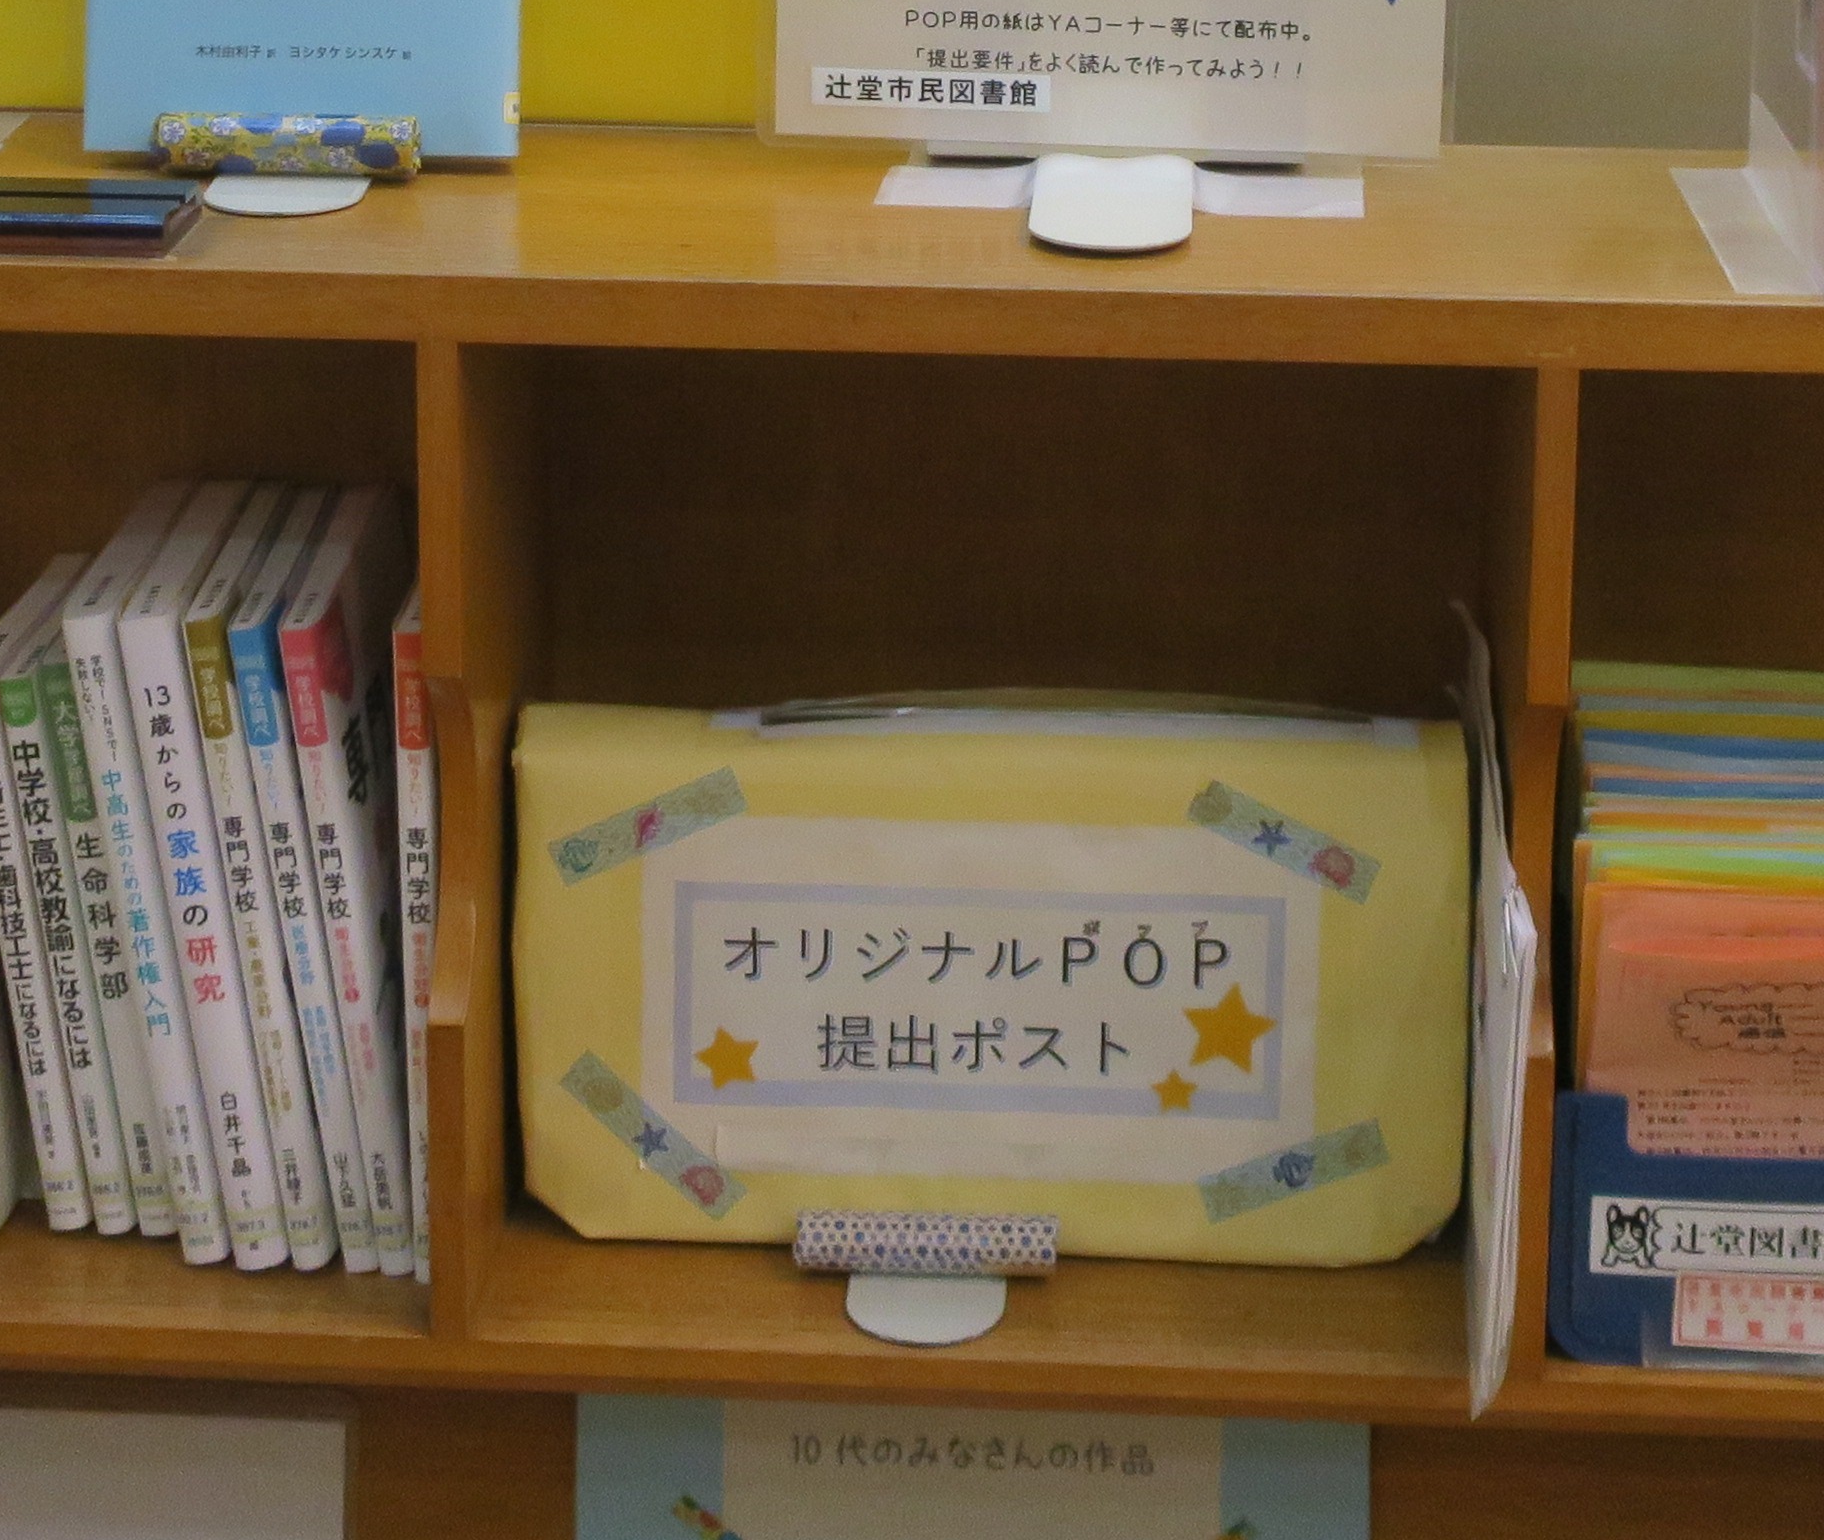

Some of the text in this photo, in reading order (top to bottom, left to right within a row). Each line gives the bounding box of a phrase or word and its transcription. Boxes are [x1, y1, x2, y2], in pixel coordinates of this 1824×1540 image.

[289, 46, 340, 59] ヨシタケ
[345, 46, 397, 60] シンスケ
[824, 74, 1040, 108] 辻堂市民図書館
[143, 686, 225, 1003] 13歳からの家族の研究
[224, 816, 259, 913] 専門学校
[269, 822, 308, 919] 専門学校
[317, 823, 351, 920] 専門学校
[406, 828, 431, 925] 専門学校
[12, 740, 92, 1070] 中学校・高校教諭になるには
[76, 833, 128, 999] 生命科学部
[102, 769, 171, 1038] 中高生のための著作権入門
[723, 928, 1231, 990] オリジナルPOP
[817, 1014, 1130, 1074] 提出ポスト
[220, 1091, 252, 1177] 白井千晶
[791, 1433, 1156, 1476] 10代のみなさんの作品
